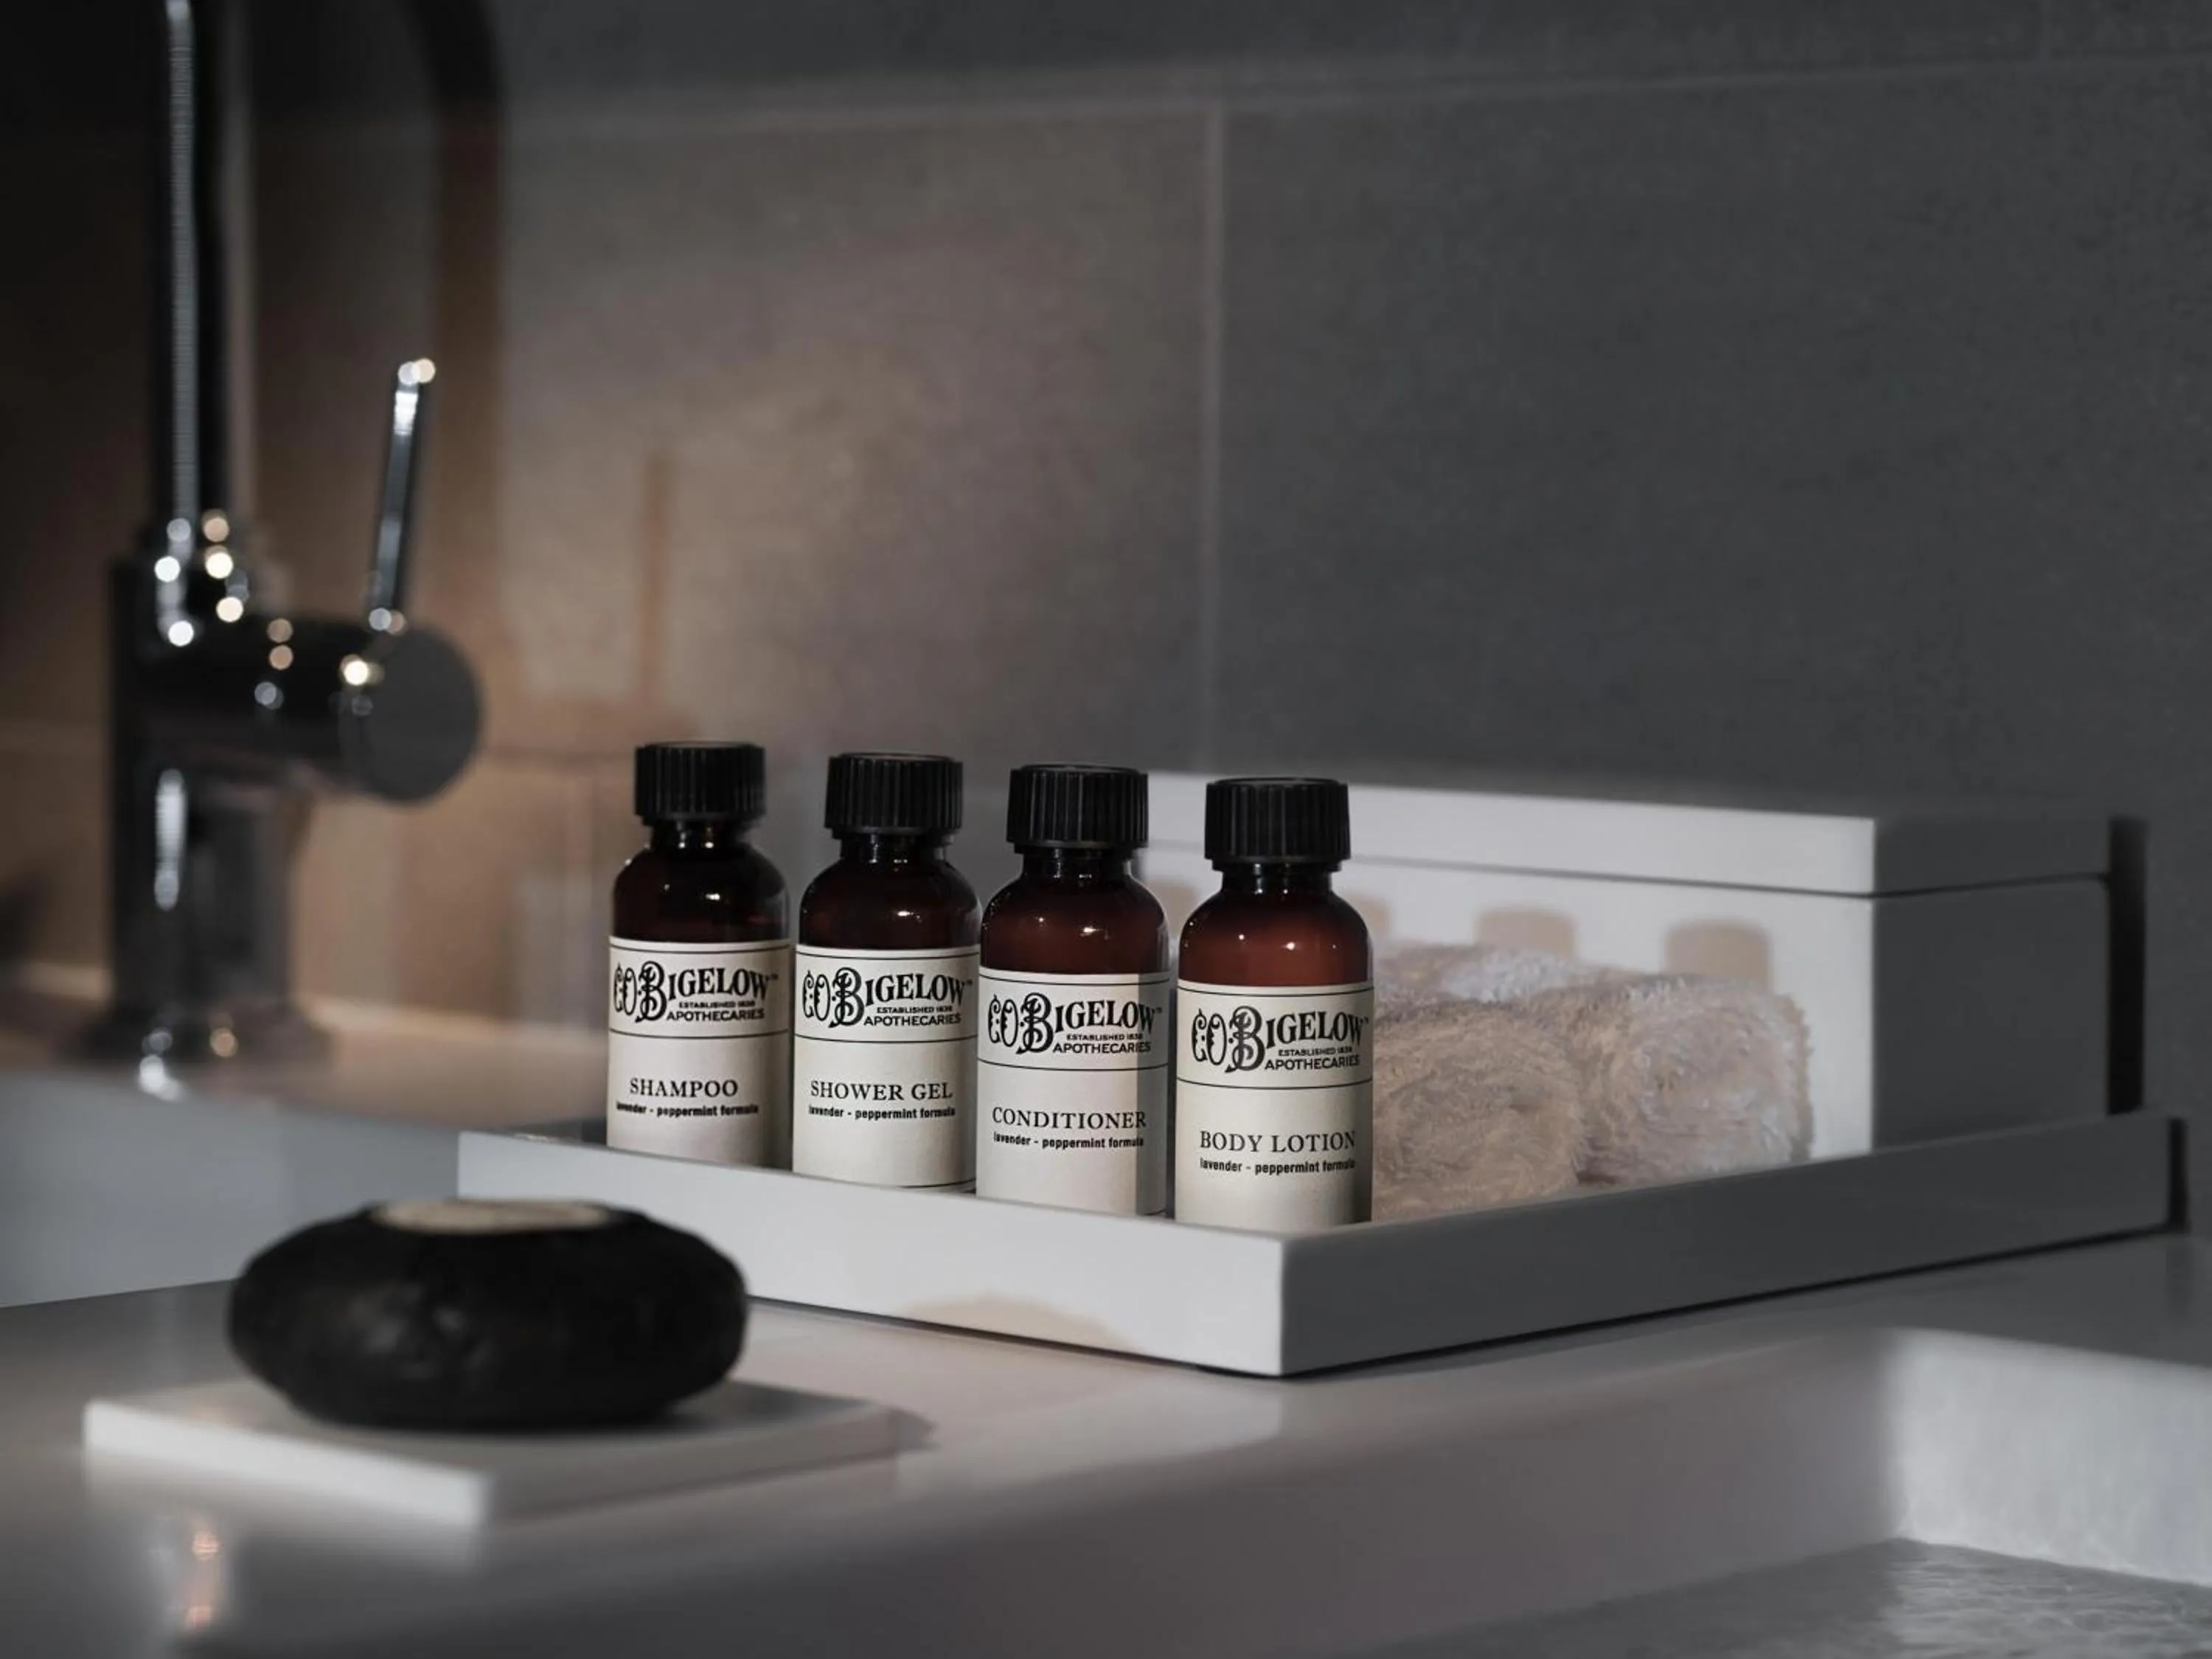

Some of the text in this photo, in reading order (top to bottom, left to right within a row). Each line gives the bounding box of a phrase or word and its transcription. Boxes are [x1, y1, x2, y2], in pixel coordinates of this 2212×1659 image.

[667, 1010, 765, 1022] APOTHECARIES
[863, 1015, 961, 1026] APOTHECARIES
[1052, 1042, 1150, 1054] APOTHECARIES
[1265, 1055, 1360, 1071] APOTHECARIES
[630, 1078, 738, 1097] SHAMPOO
[810, 1080, 953, 1100] SHOWER GEL
[616, 1101, 647, 1114] lavender
[658, 1106, 717, 1118] peppermint
[720, 1104, 759, 1115] formula
[809, 1105, 844, 1117] lavender
[855, 1107, 917, 1120] peppermint
[920, 1106, 956, 1118] formula
[992, 1107, 1147, 1129] CONDITIONER
[993, 1132, 1031, 1146] lavender
[1042, 1138, 1105, 1150] peppermint
[1108, 1137, 1144, 1148] formula
[1200, 1131, 1355, 1152] BODY LOTION
[1200, 1158, 1242, 1172] lavender
[1255, 1161, 1319, 1175] peppermint
[1323, 1158, 1355, 1171] formula
